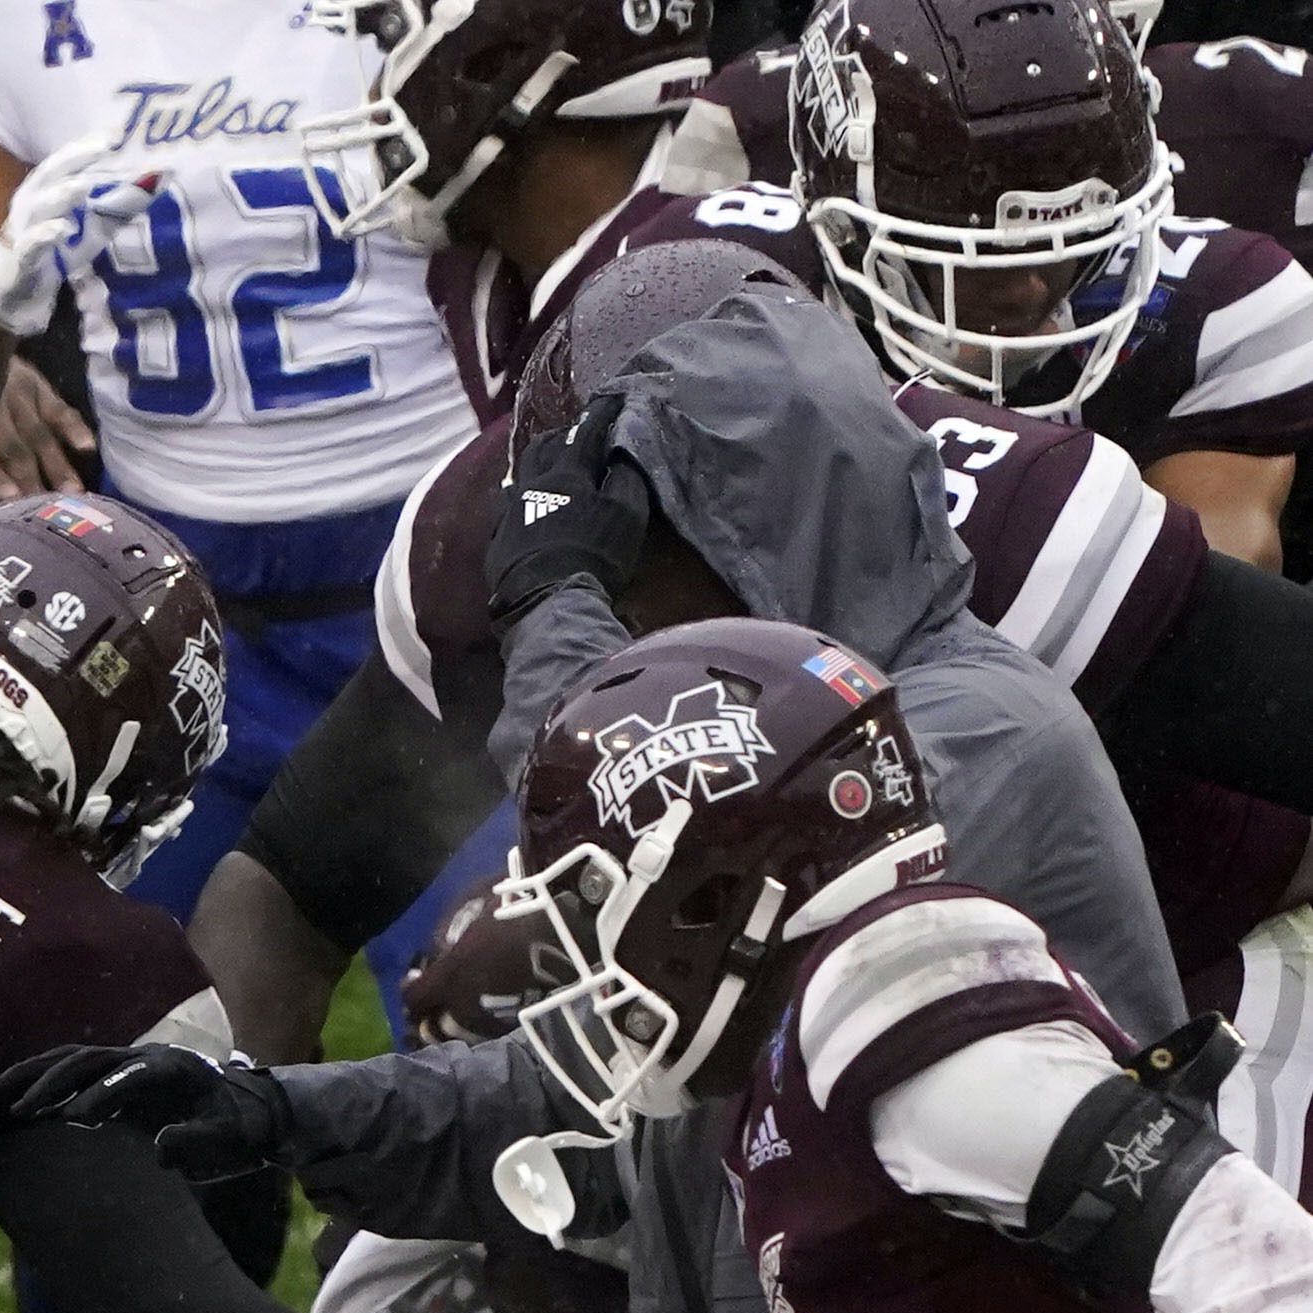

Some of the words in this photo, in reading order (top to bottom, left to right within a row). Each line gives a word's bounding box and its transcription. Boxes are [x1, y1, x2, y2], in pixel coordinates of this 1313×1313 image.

[111, 77, 301, 152] Tulsa
[64, 162, 382, 418] 82
[521, 489, 572, 506] adidas
[44, 591, 87, 631] SEC
[618, 724, 730, 791] STATE
